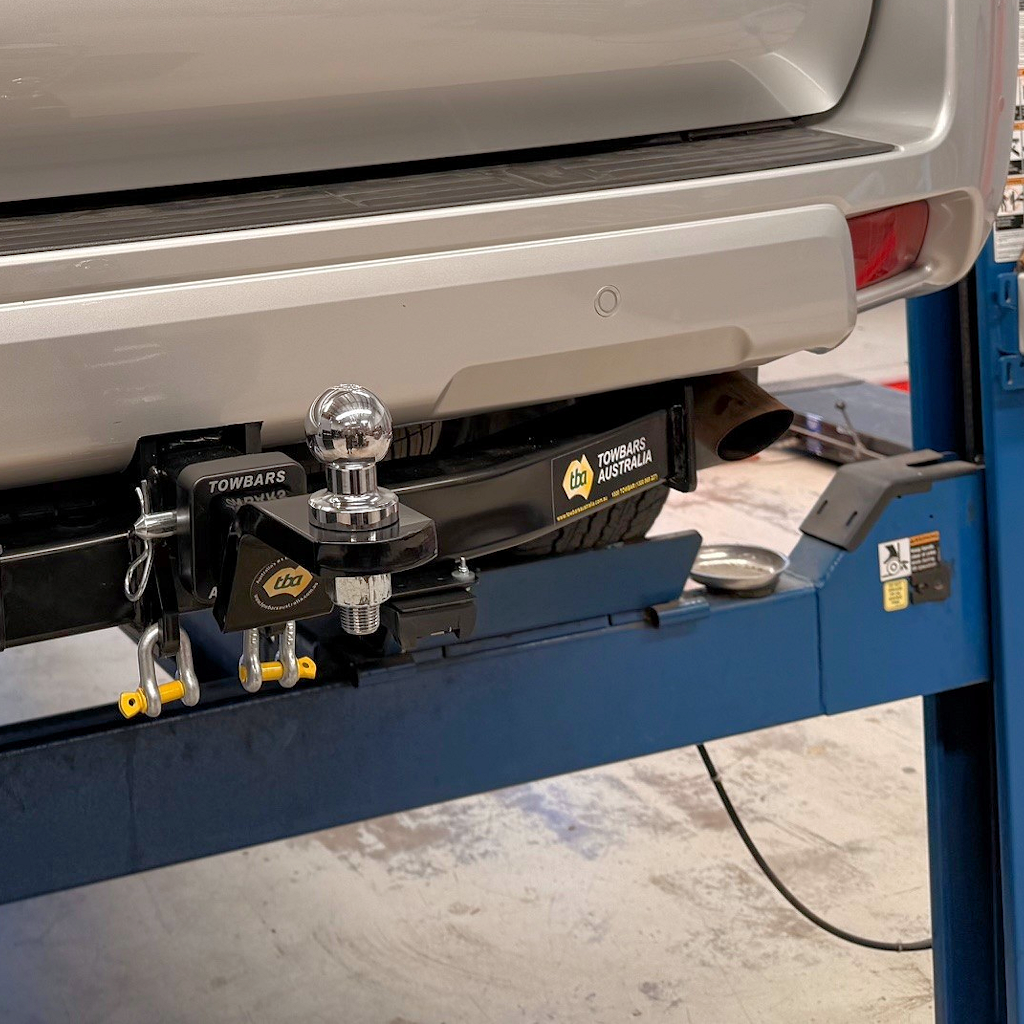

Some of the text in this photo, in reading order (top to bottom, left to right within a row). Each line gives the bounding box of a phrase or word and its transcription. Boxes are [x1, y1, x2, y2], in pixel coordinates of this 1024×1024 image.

[597, 436, 647, 468] TOWBARS
[569, 467, 588, 490] tba
[597, 449, 653, 485] AUSTRALIA
[208, 469, 286, 494] TOWBARS
[273, 573, 304, 591] tba
